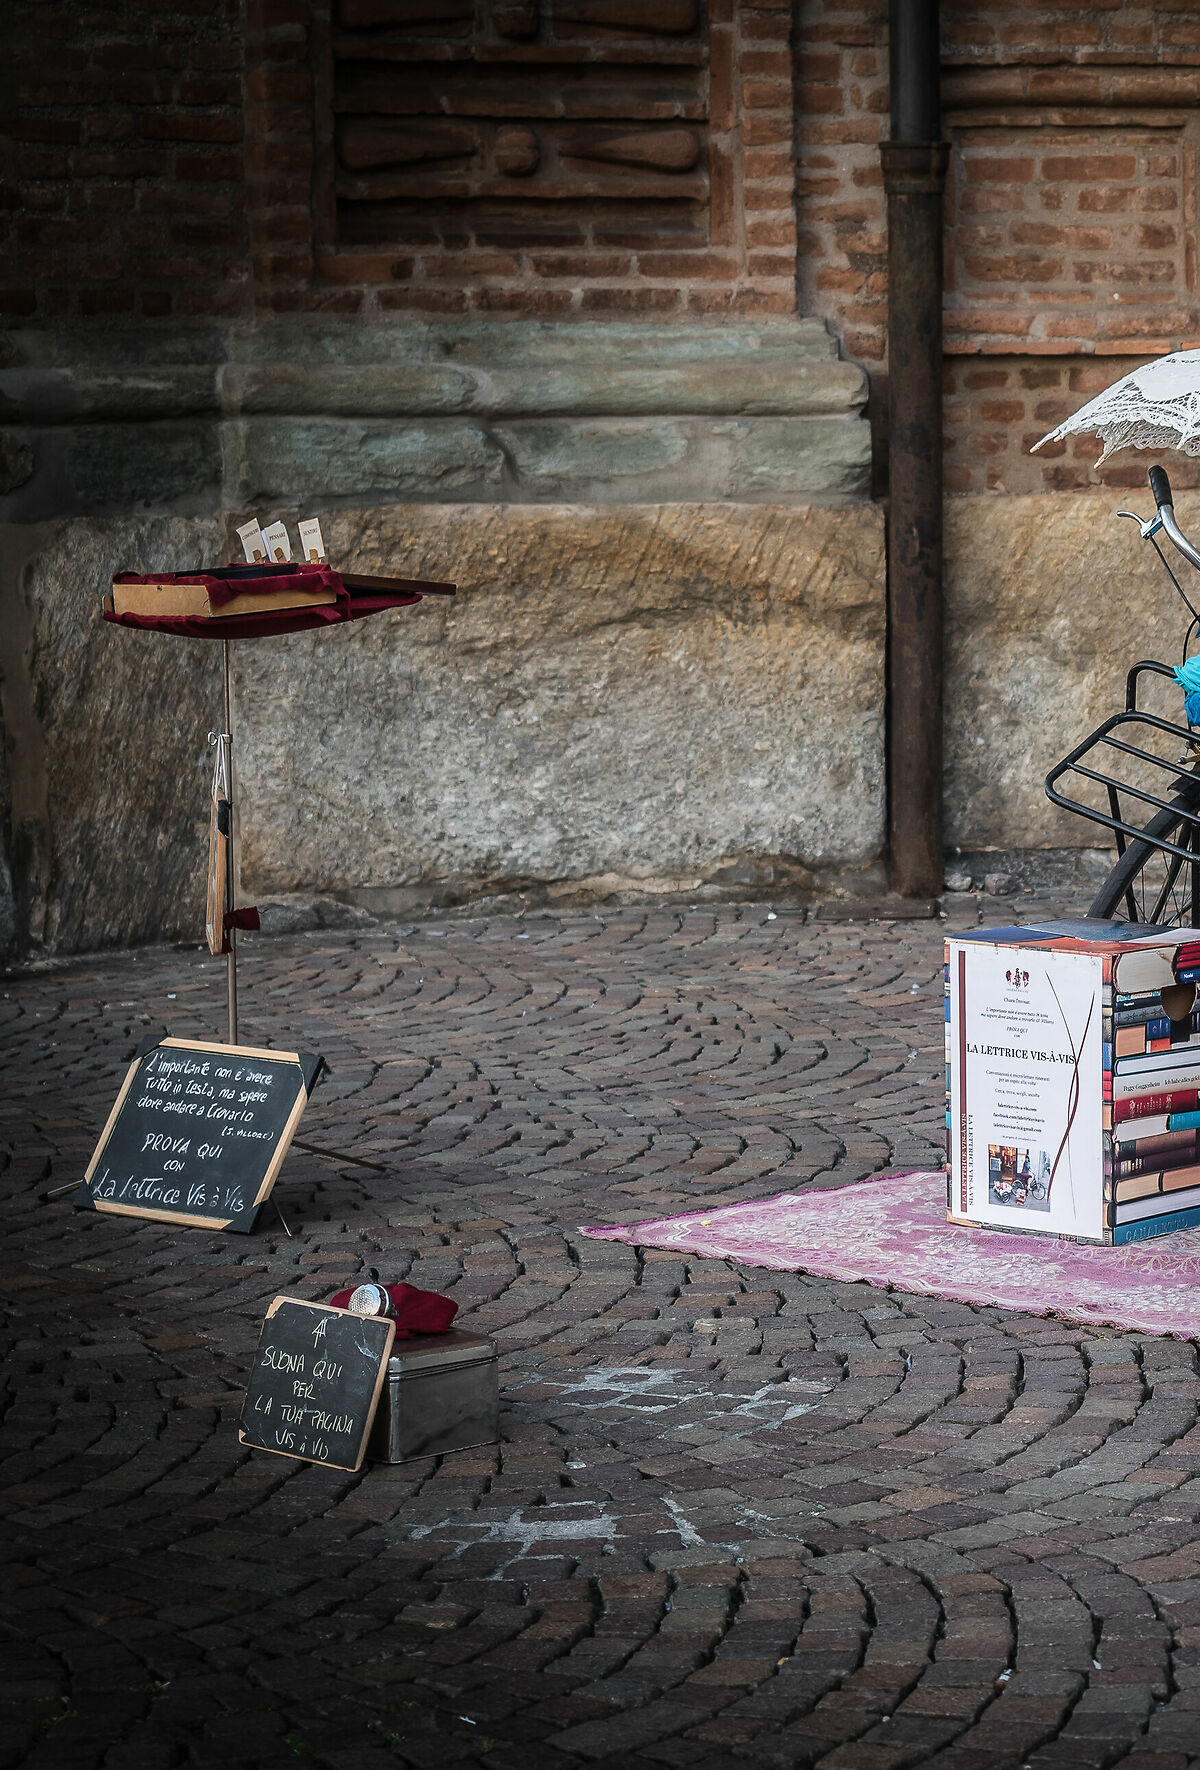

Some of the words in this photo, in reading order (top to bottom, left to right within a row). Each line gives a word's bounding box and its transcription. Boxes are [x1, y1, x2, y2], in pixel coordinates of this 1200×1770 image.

[967, 1043, 979, 1054] LA
[981, 1045, 1028, 1060] LETTRICE
[1030, 1050, 1076, 1065] VIS-À-VIS
[145, 1053, 210, 1078] L'importante
[215, 1067, 232, 1079] non
[234, 1067, 245, 1081] è
[246, 1071, 273, 1085] avere
[173, 1079, 182, 1094] in
[185, 1079, 216, 1100] testa,
[219, 1088, 236, 1100] ma
[238, 1090, 268, 1106] sapere
[138, 1095, 163, 1110] dove
[163, 1100, 197, 1114] andare
[196, 1106, 205, 1116] a
[206, 1103, 255, 1122] trovarlo
[140, 1132, 192, 1154] PROVA
[197, 1142, 223, 1160] QUI
[163, 1159, 185, 1173] CON
[92, 1168, 116, 1199] La
[119, 1174, 181, 1205] Lettrice
[186, 1182, 207, 1207] Vis
[209, 1186, 220, 1208] à
[224, 1184, 245, 1212] Vis
[260, 1345, 305, 1373] SUONA
[313, 1360, 343, 1380] QUI
[292, 1380, 316, 1400] PER
[254, 1394, 272, 1415] LA
[280, 1404, 304, 1425] TUA
[311, 1410, 354, 1436] PAGINA
[275, 1428, 295, 1449] VIS
